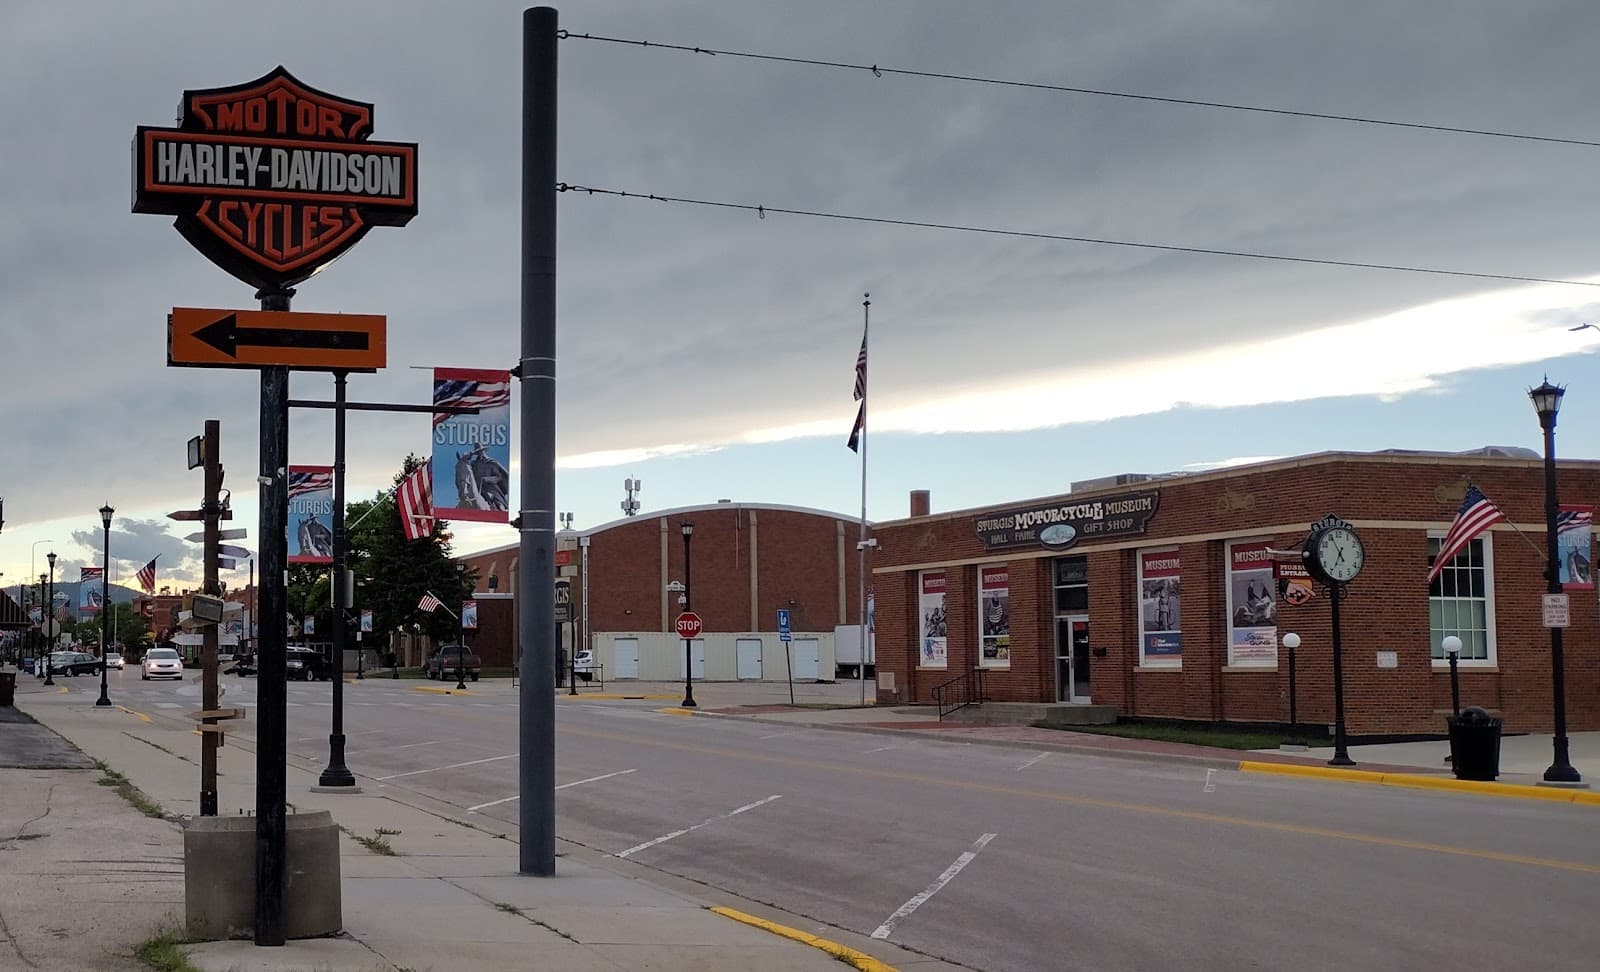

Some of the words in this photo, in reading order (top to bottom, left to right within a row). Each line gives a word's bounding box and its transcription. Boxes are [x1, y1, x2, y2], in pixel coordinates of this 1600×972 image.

[216, 87, 345, 138] MOTOR
[157, 141, 402, 196] HARLEY-DAVIDSON
[219, 201, 344, 260] CYCLES
[435, 422, 507, 445] STURGIS
[976, 516, 1014, 532] STURGIS
[1014, 502, 1103, 530] MOTORCYCLE
[1105, 497, 1152, 515] MUSEUM
[990, 533, 1009, 545] HALL
[1014, 529, 1037, 542] FAME
[1083, 521, 1104, 534] GIFT
[1106, 518, 1134, 532] SHOP
[677, 620, 700, 630] STOP
